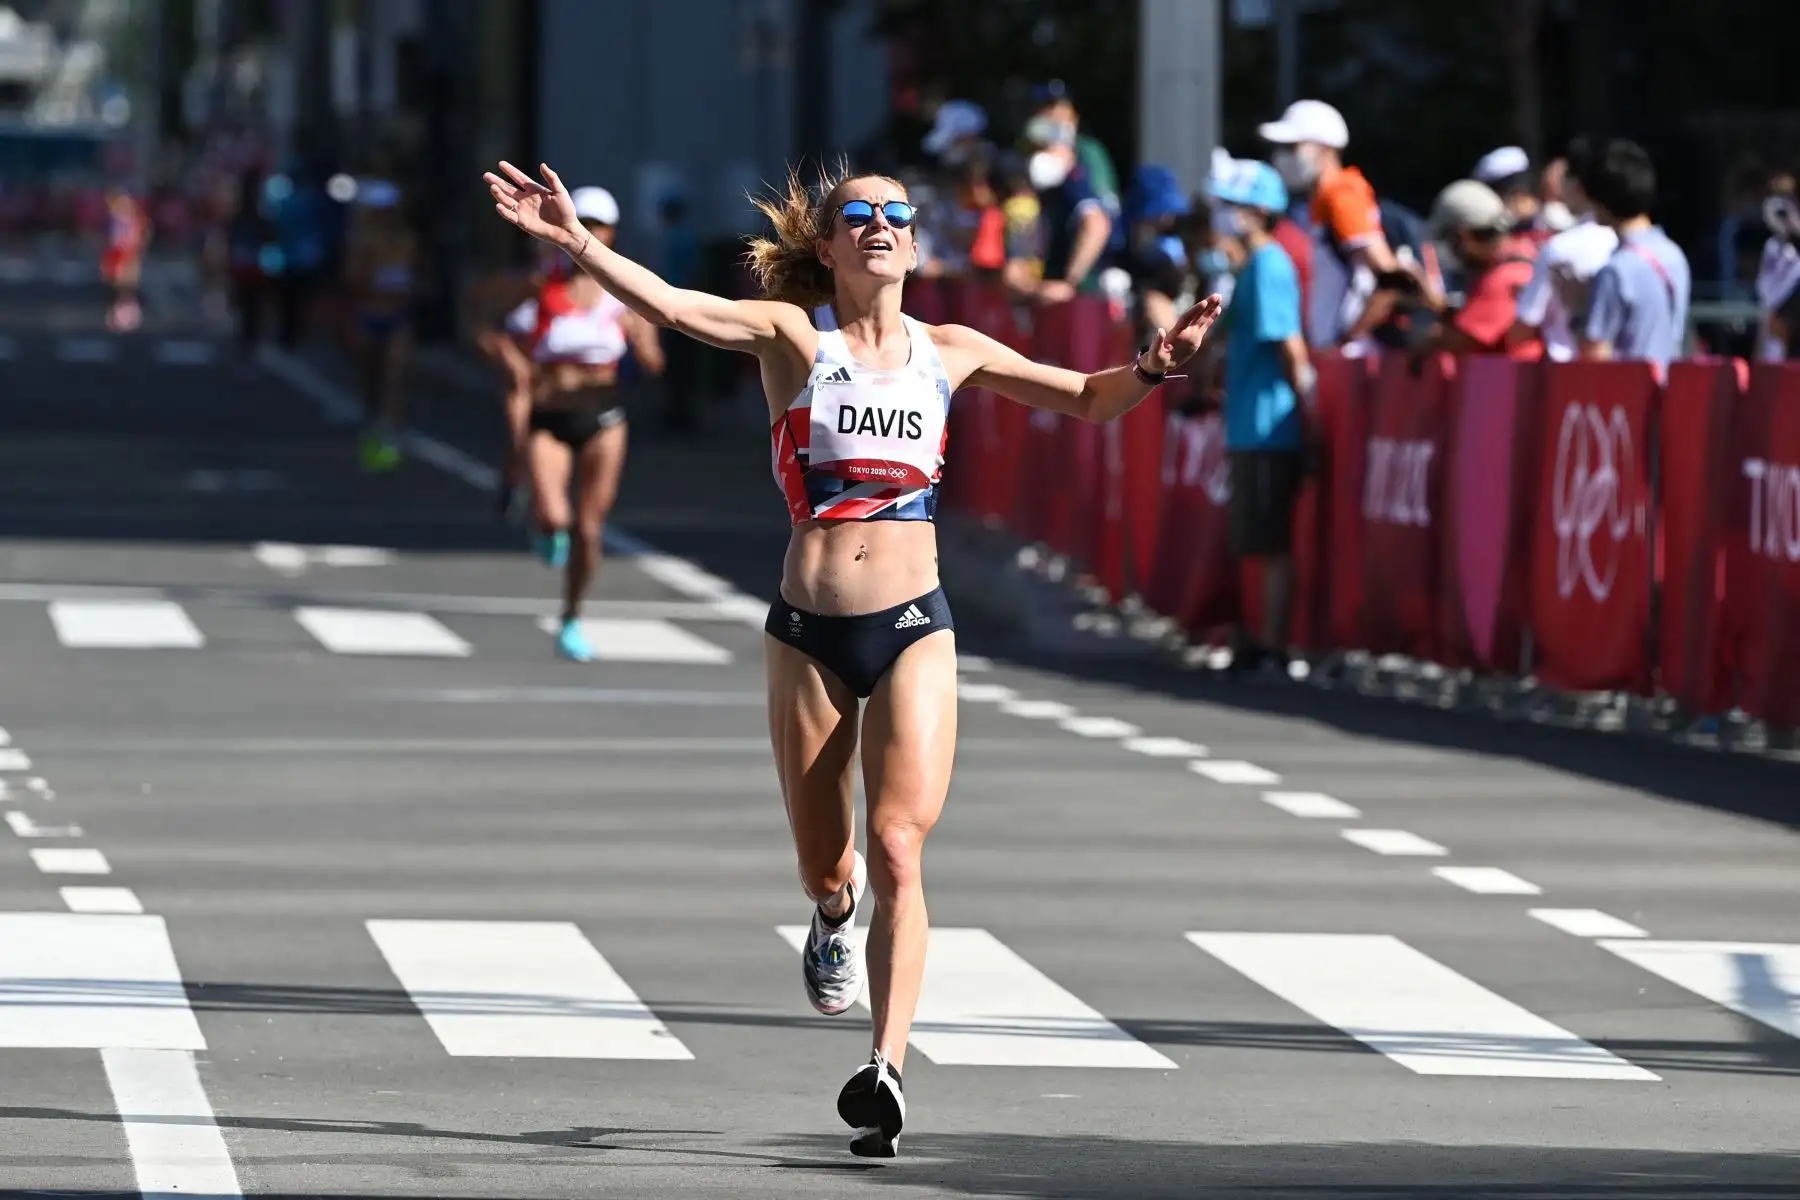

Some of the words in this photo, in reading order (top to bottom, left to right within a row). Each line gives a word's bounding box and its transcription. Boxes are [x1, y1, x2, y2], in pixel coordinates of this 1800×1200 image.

[837, 404, 922, 440] DAVIS
[848, 466, 870, 474] TOKYO
[870, 467, 887, 475] 2020
[895, 616, 930, 629] adidas
